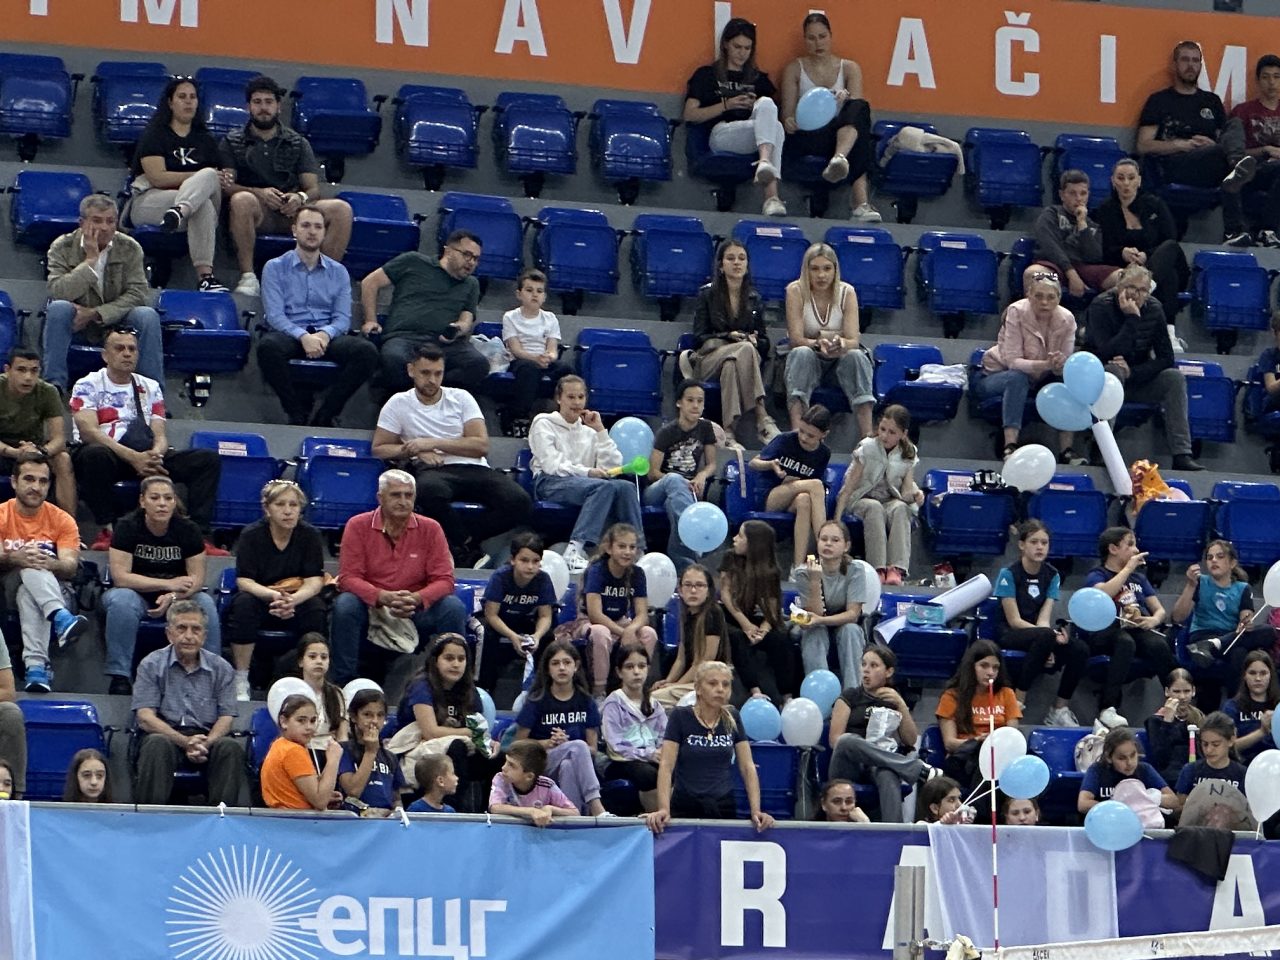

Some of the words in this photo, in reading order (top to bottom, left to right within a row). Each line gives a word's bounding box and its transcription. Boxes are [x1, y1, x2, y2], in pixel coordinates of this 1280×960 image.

[135, 544, 182, 560] AMOUR
[541, 713, 567, 725] LUKA
[568, 711, 587, 724] BAR
